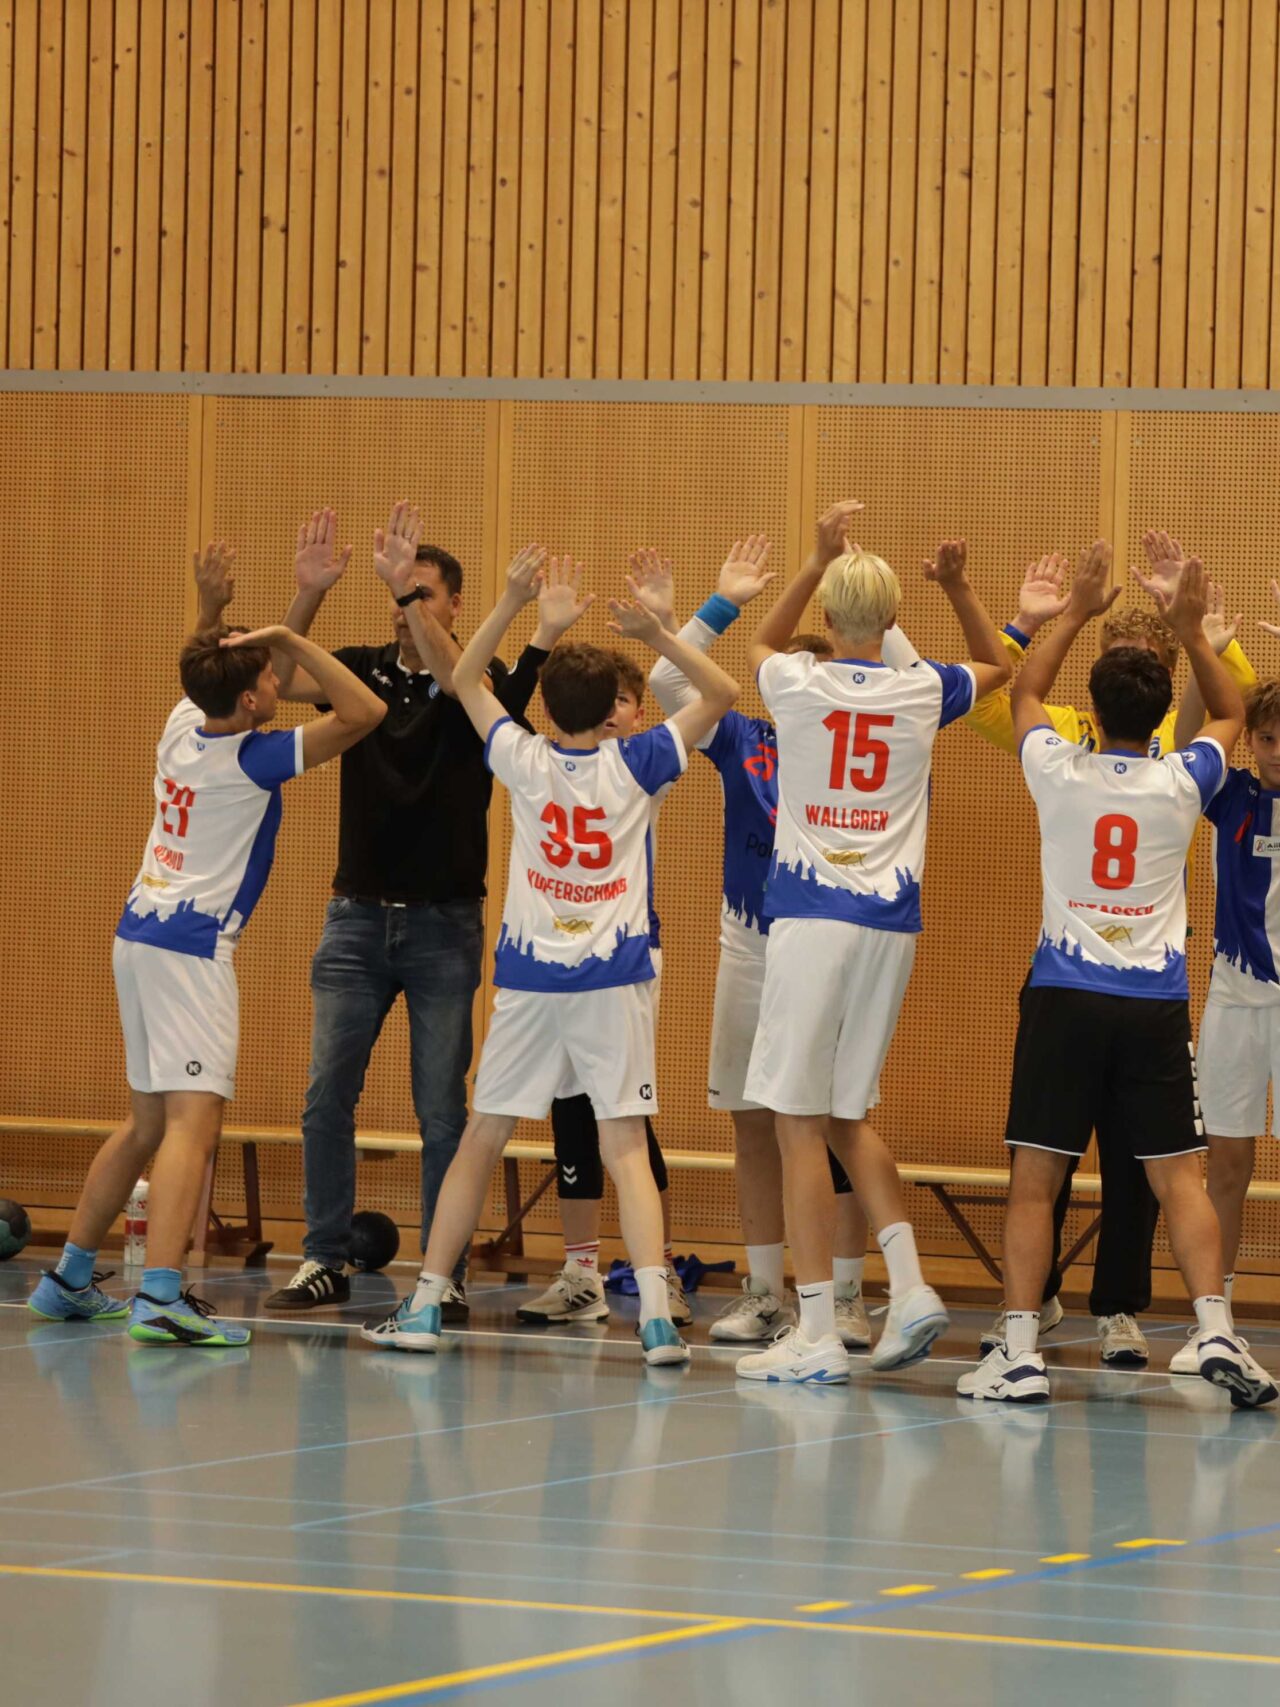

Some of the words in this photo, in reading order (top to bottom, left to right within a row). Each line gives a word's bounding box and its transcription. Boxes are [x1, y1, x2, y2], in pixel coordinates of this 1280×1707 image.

[822, 710, 895, 792] 15
[540, 801, 613, 870] 35
[806, 804, 889, 831] WALLGREN
[1092, 813, 1138, 890] 8
